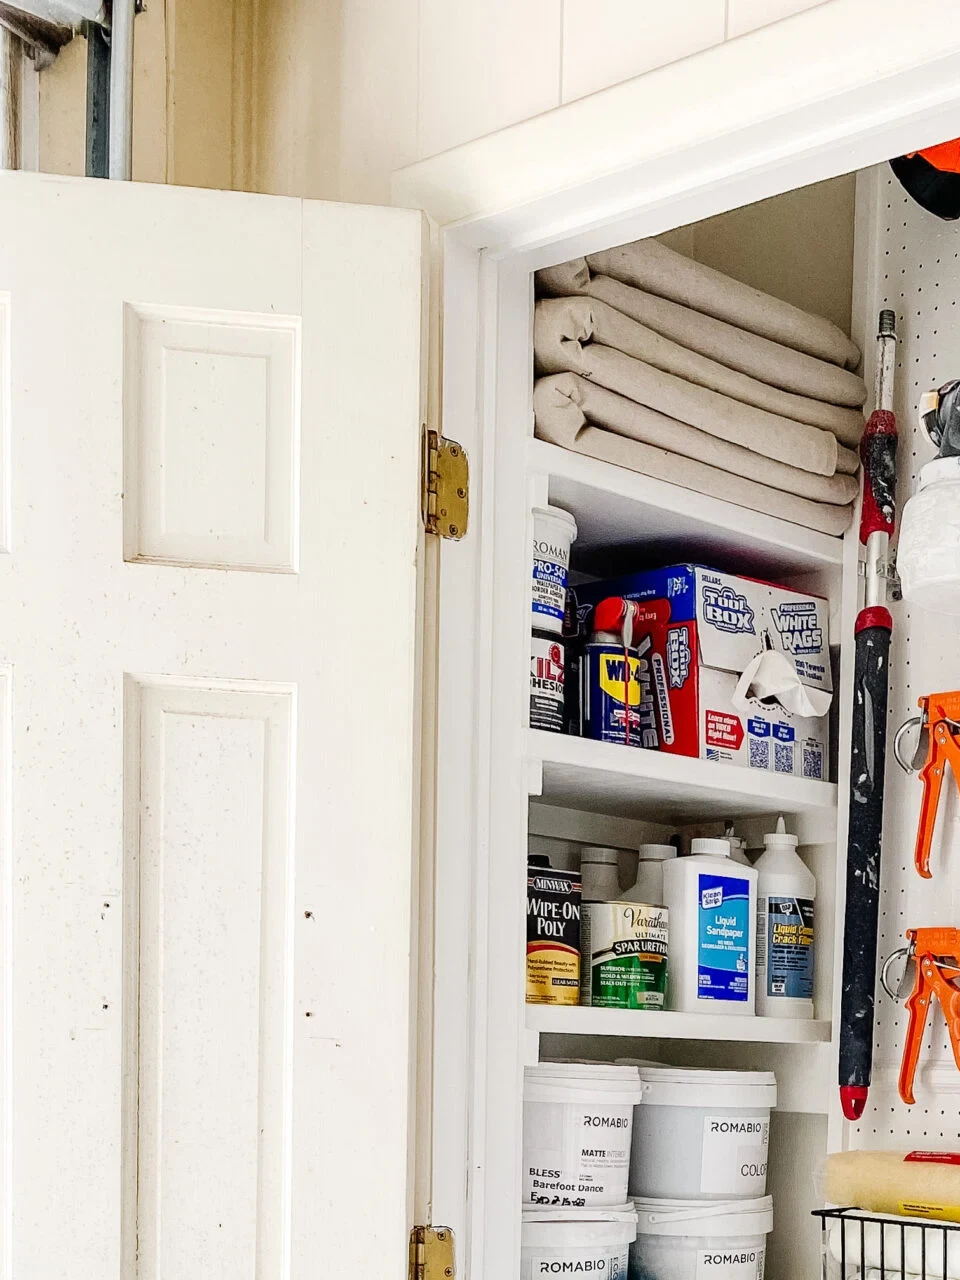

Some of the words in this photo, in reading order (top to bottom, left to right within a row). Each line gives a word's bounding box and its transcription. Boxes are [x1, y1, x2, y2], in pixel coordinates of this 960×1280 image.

[705, 590, 747, 612] TOOL
[707, 605, 752, 629] BOX
[771, 609, 817, 632] WHITE
[781, 630, 823, 654] RAGS
[653, 658, 672, 742] PROFESSIONAL
[536, 878, 569, 892] MINWAX
[527, 897, 580, 921] WIPE-ON
[537, 917, 566, 937] POLY
[715, 915, 736, 928] Liquid
[773, 923, 797, 934] Liquid
[706, 925, 744, 939] Sandpaper
[772, 934, 797, 944] Crack
[615, 942, 640, 954] SPAR
[583, 1115, 629, 1129] ROMABIO
[711, 1122, 762, 1133] ROMABIO
[581, 1149, 606, 1157] MATTE
[532, 1179, 576, 1191] Barefoot
[578, 1185, 604, 1193] Dance
[703, 1252, 756, 1265] ROMABIO
[540, 1259, 605, 1273] ROMABIO
